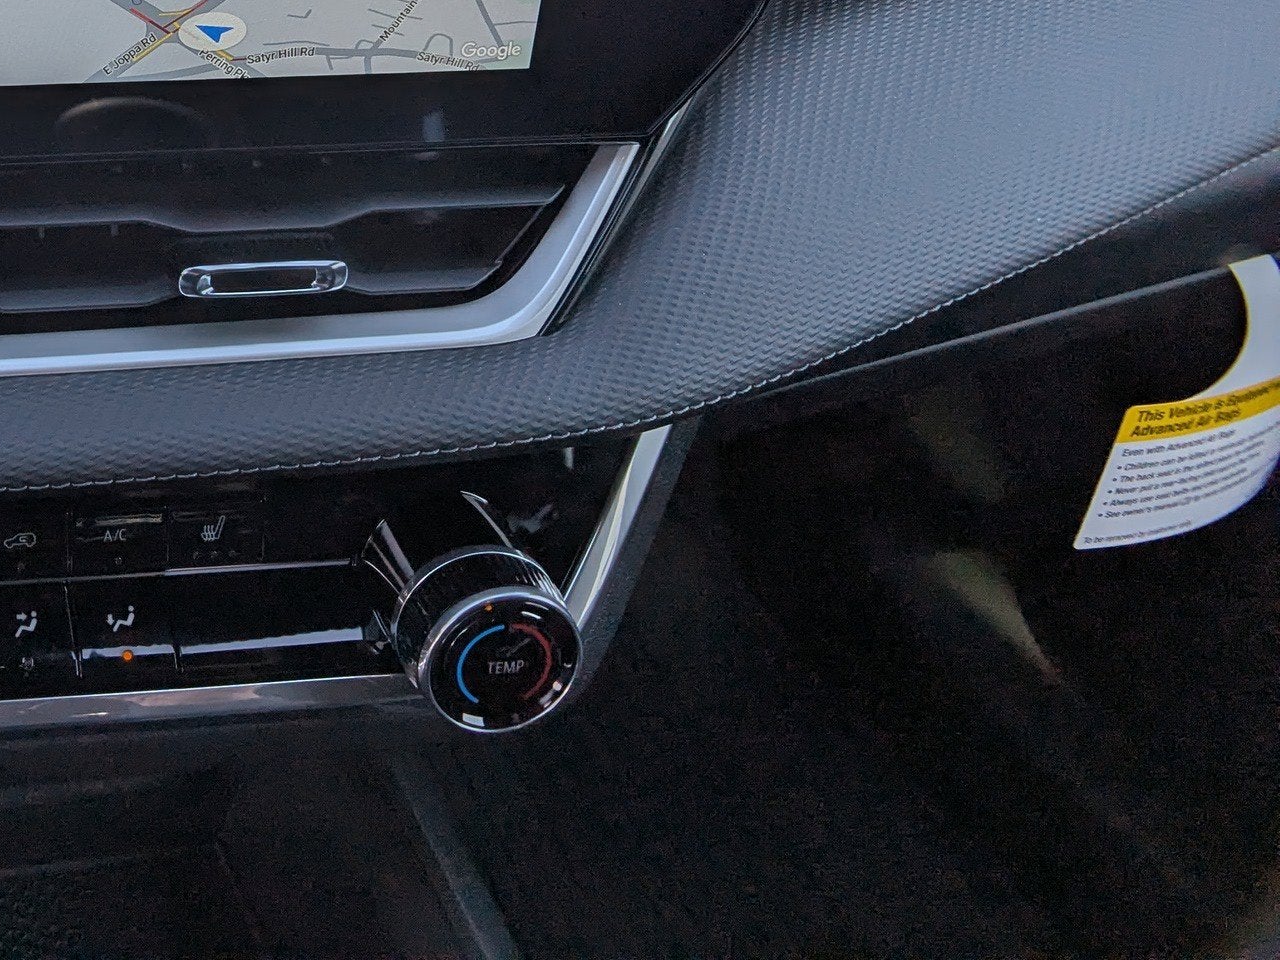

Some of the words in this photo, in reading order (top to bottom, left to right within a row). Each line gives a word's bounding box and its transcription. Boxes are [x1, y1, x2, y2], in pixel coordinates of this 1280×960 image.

[102, 66, 112, 76] E
[113, 44, 142, 70] Joppa
[140, 33, 157, 48] Rd
[246, 51, 276, 65] Satyr
[277, 48, 296, 60] Hill
[298, 46, 315, 58] Rd
[461, 41, 522, 60] Google
[198, 49, 235, 76] Perring
[416, 51, 444, 66] Satyr
[445, 56, 464, 69] Hill
[464, 61, 480, 71] Rd
[1138, 410, 1166, 423] This
[103, 528, 127, 542] A/C
[487, 659, 526, 675] TEMP
